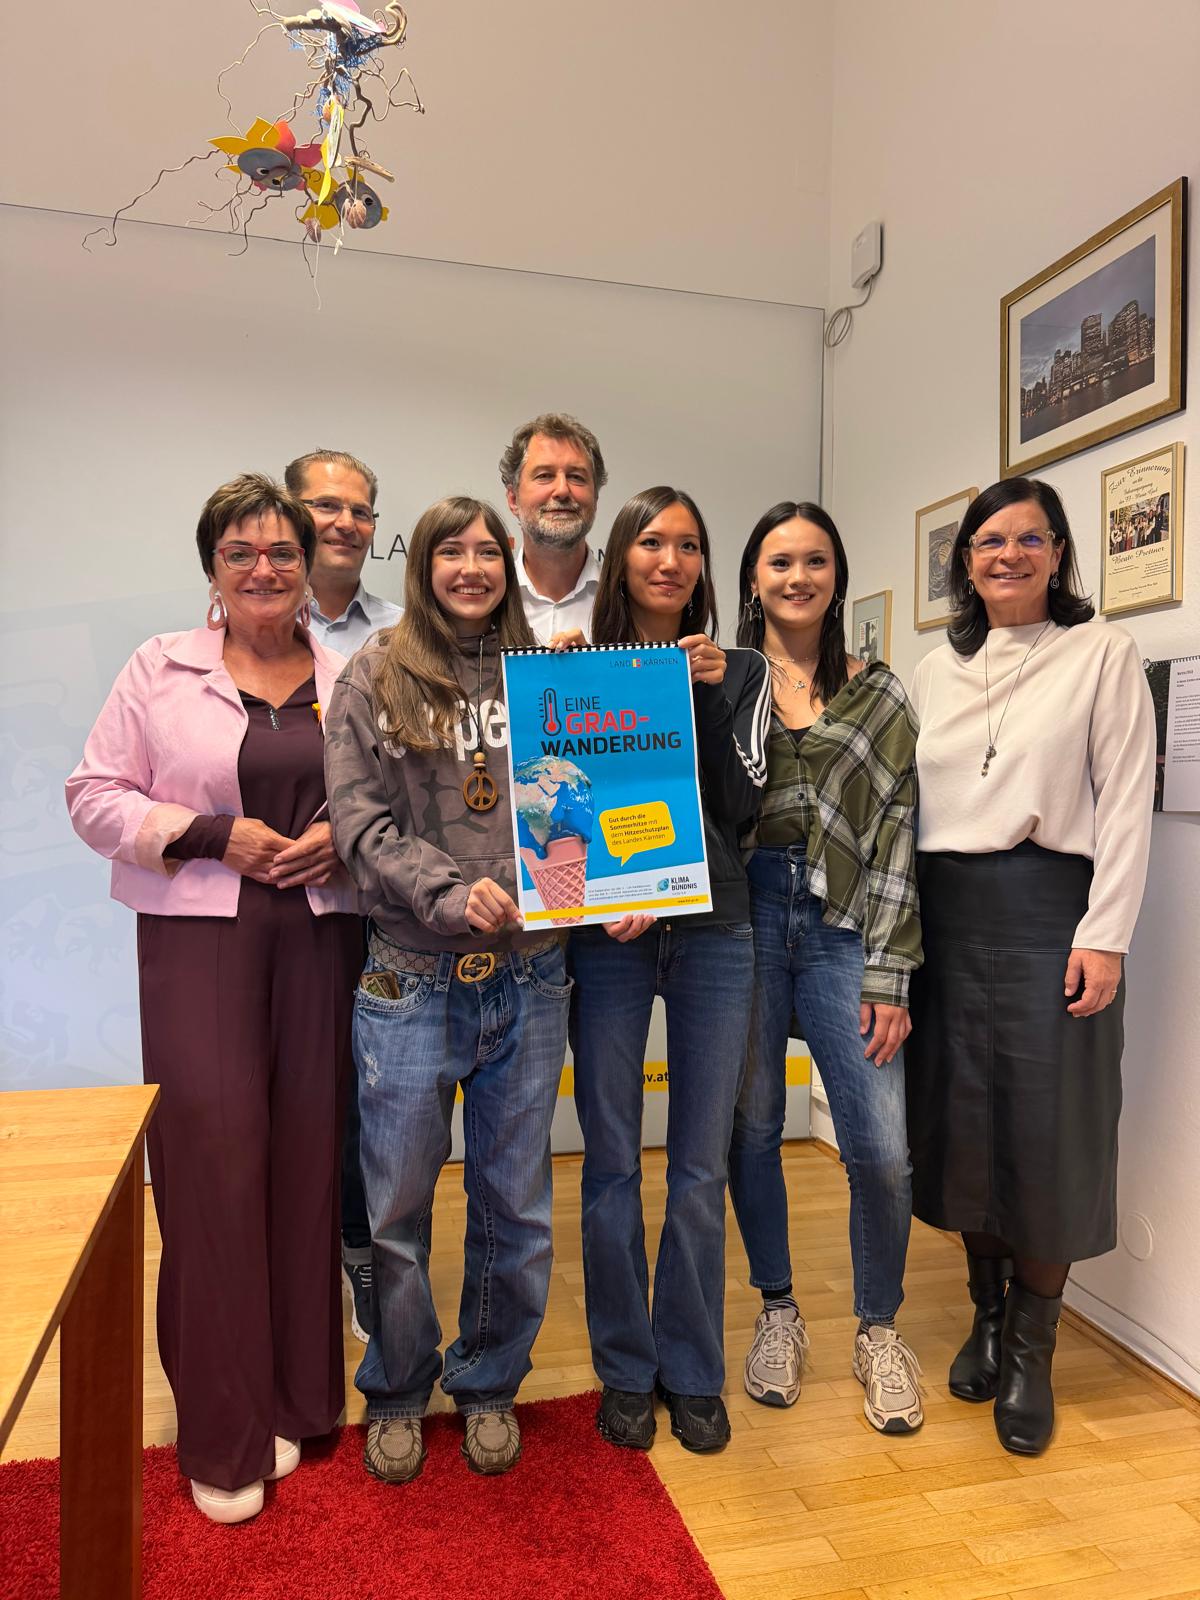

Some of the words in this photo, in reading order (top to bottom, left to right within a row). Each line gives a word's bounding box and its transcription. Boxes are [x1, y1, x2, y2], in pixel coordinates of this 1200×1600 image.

[370, 534, 408, 561] LA
[609, 660, 633, 668] LAND
[643, 658, 678, 666] KÄRNTEN
[565, 696, 601, 711] EINE
[566, 709, 650, 735] GRAD-
[541, 731, 682, 757] WANDERUNG
[609, 822, 648, 830] Sommerhitze
[624, 826, 670, 836] Hitzeschutzplan
[671, 876, 690, 884] KLIMA
[671, 883, 698, 891] BÜNDNIS
